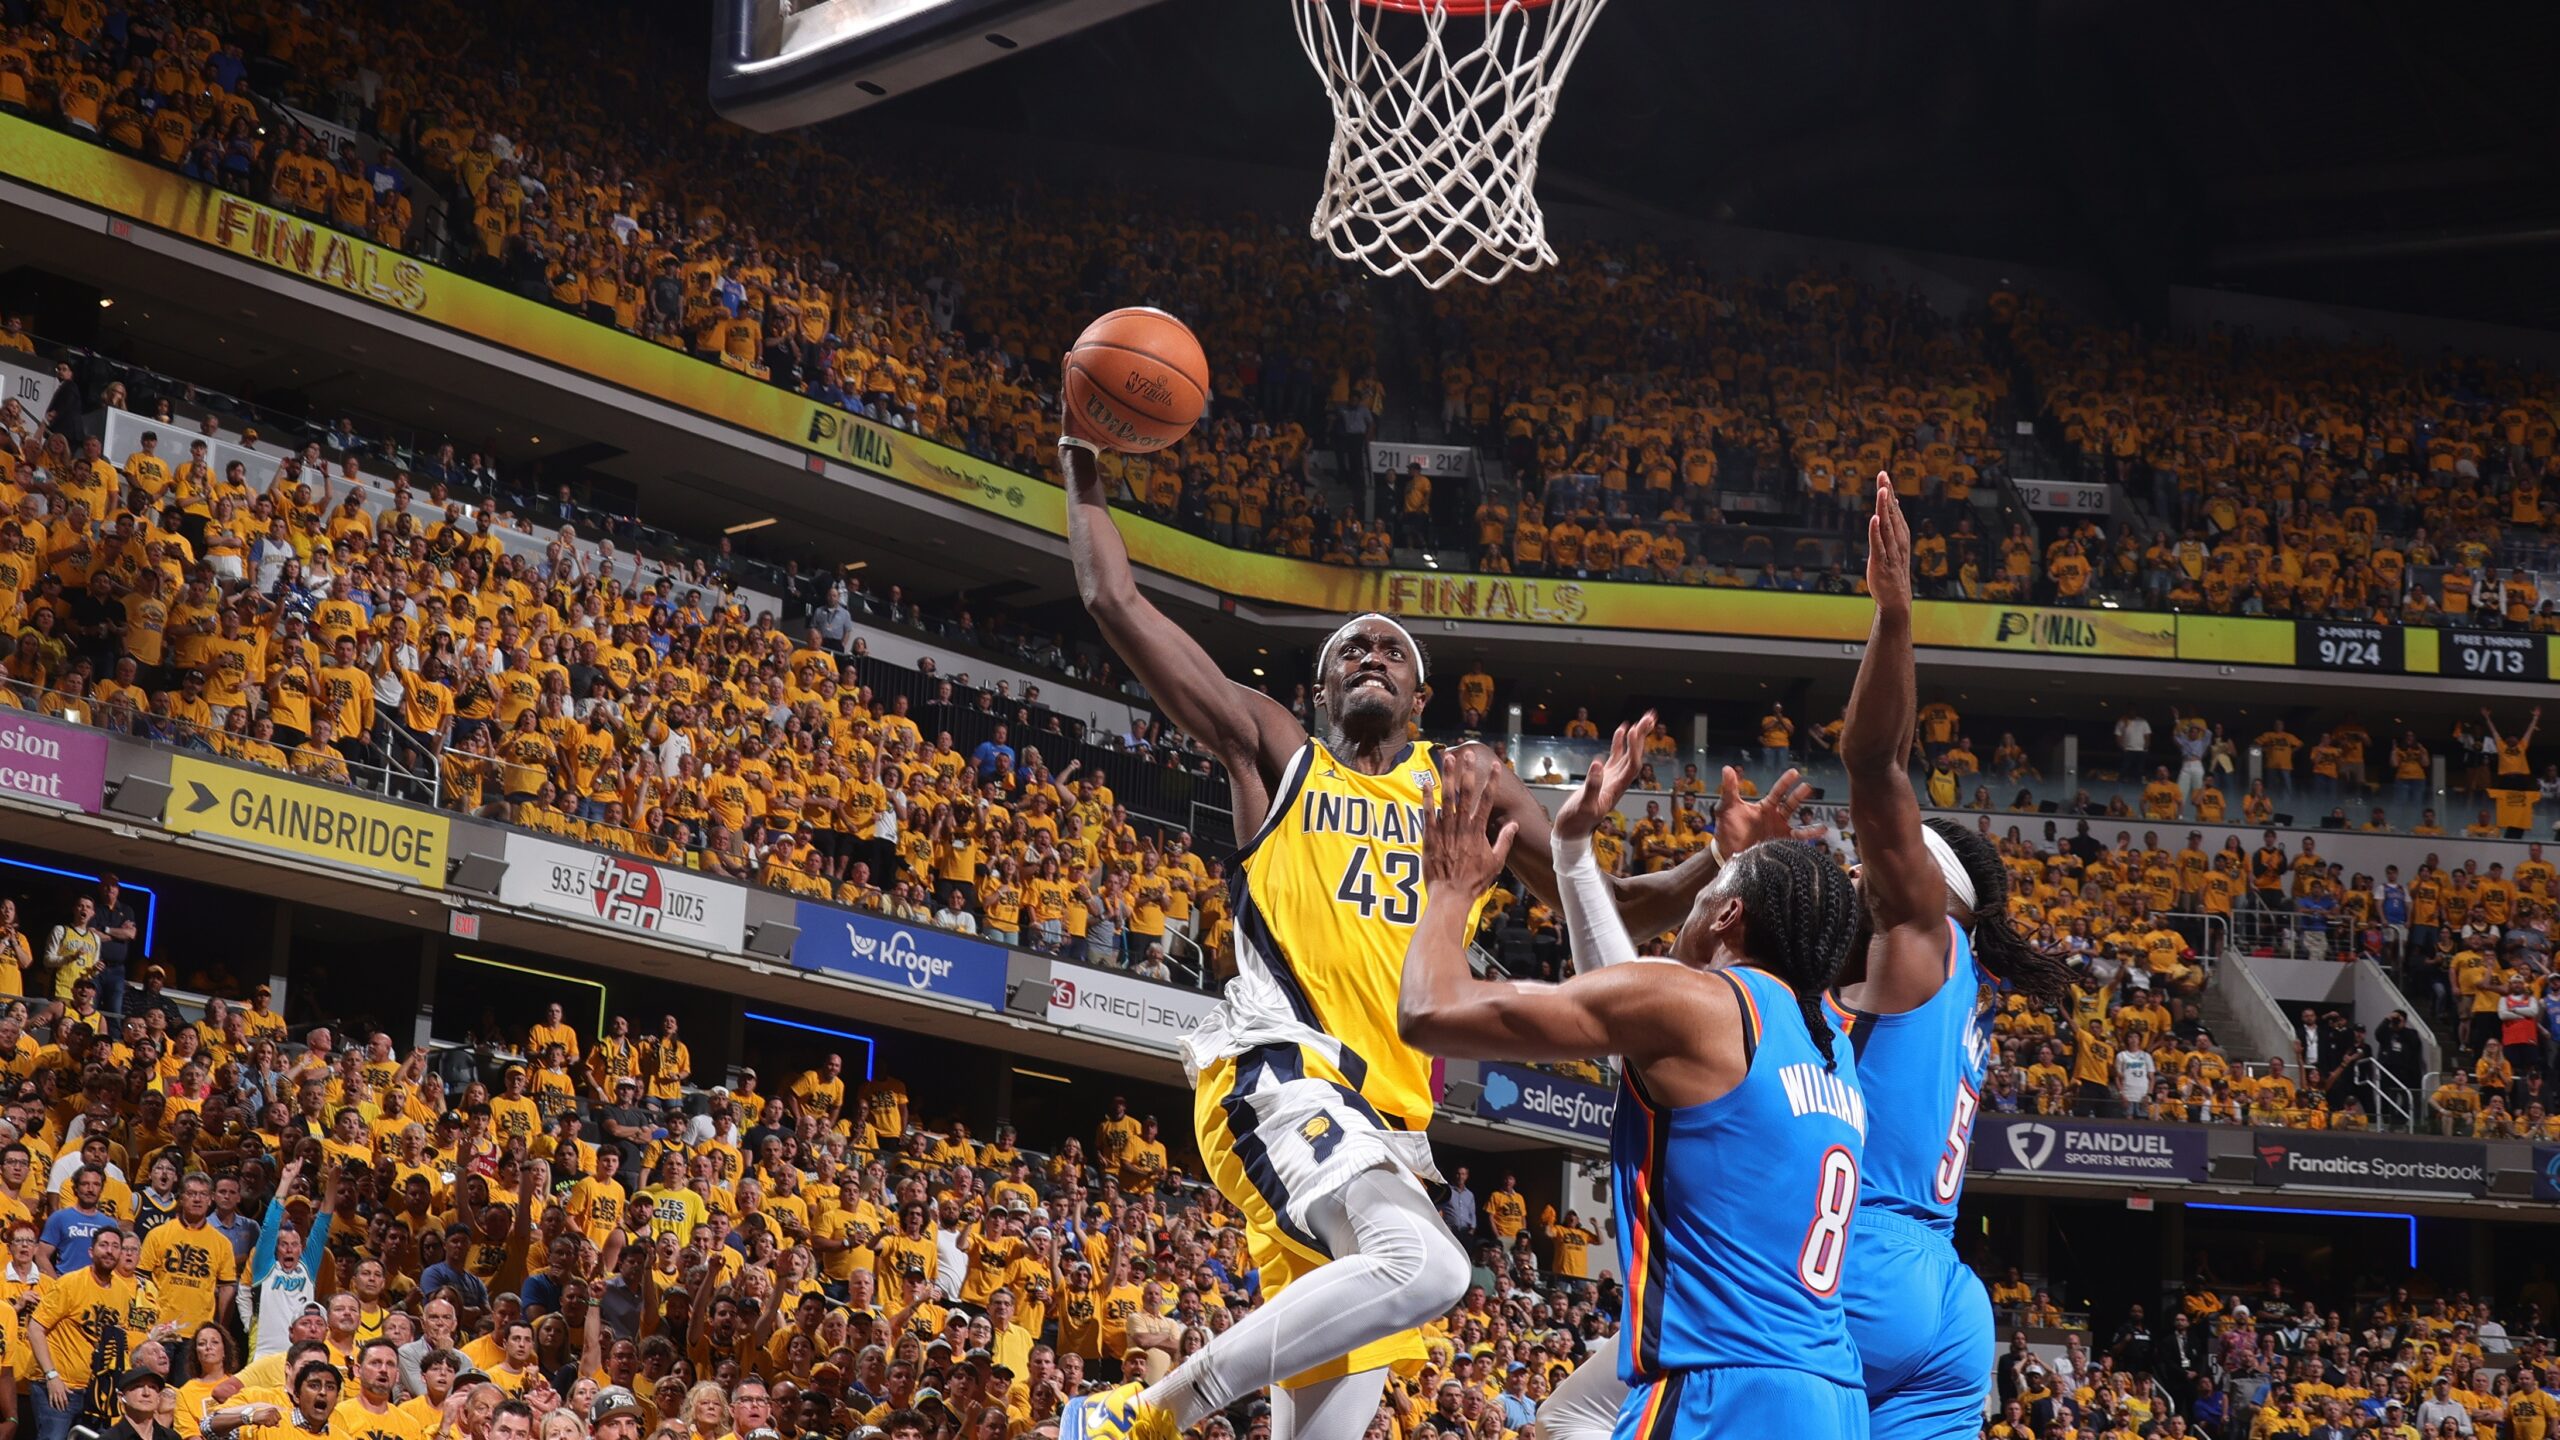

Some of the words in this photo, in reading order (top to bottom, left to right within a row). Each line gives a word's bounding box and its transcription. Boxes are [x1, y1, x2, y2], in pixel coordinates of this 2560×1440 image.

[215, 195, 427, 311] FINALS
[17, 375, 41, 402] 106
[1132, 377, 1176, 407] Finals
[1087, 393, 1169, 447] Wilson
[1378, 450, 1400, 468] 211
[1436, 454, 1463, 472] 212
[2078, 490, 2104, 509] 213
[1388, 572, 1588, 623] FINALS
[2317, 626, 2365, 640] 3-POINT
[2453, 633, 2482, 646] FREE
[2483, 636, 2533, 649] THROWS
[2318, 640, 2381, 666] 9/24
[2463, 648, 2525, 674] 9/13
[229, 787, 434, 869] GAINBRIDGE
[1302, 790, 1428, 844] INDIAN
[551, 865, 586, 896] 93.5
[589, 854, 649, 899] the
[1336, 846, 1421, 926] 43
[600, 890, 663, 931] fan
[667, 891, 705, 922] 107.5
[455, 914, 476, 935] EXIT
[879, 930, 953, 990] Kroger
[1522, 1084, 1615, 1128] salesforc
[1778, 1062, 1865, 1147] WILLIAM
[1935, 1076, 1980, 1205] 5
[2064, 1130, 2174, 1155] FANDUEL
[2064, 1152, 2112, 1167] SPORTS
[2113, 1154, 2174, 1170] NETWORK
[2288, 1152, 2369, 1175] Fanatics
[2371, 1157, 2483, 1181] Sportsbook
[652, 1208, 687, 1223] CERS
[659, 1198, 684, 1211] YES
[1797, 1144, 1861, 1298] 8
[164, 1256, 210, 1279] CERS
[175, 1243, 210, 1263] YES
[271, 1274, 307, 1293] INDY
